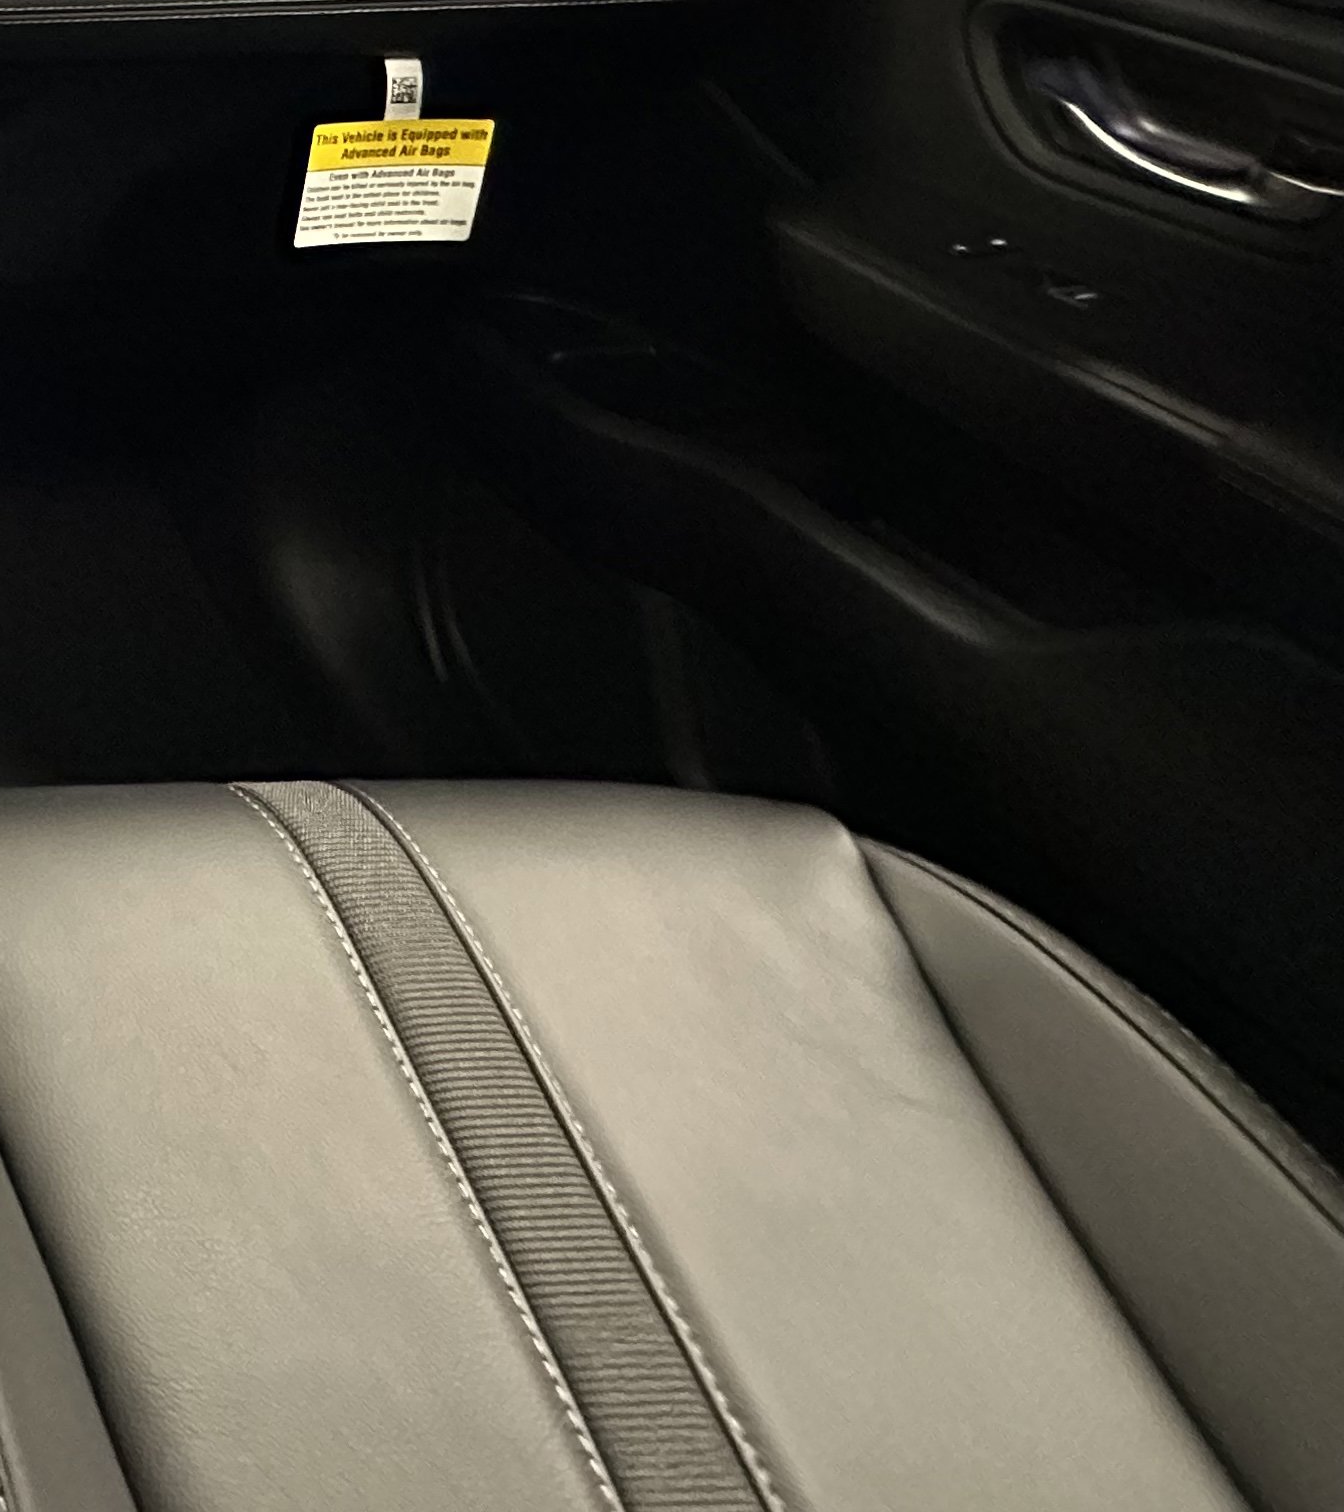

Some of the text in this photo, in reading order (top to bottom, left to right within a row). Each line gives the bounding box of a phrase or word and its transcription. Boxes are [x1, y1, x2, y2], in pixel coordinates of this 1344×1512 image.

[316, 127, 489, 146] This Vehicle is Equipped with
[340, 144, 451, 160] Advanced Air Bags
[351, 170, 370, 180] with
